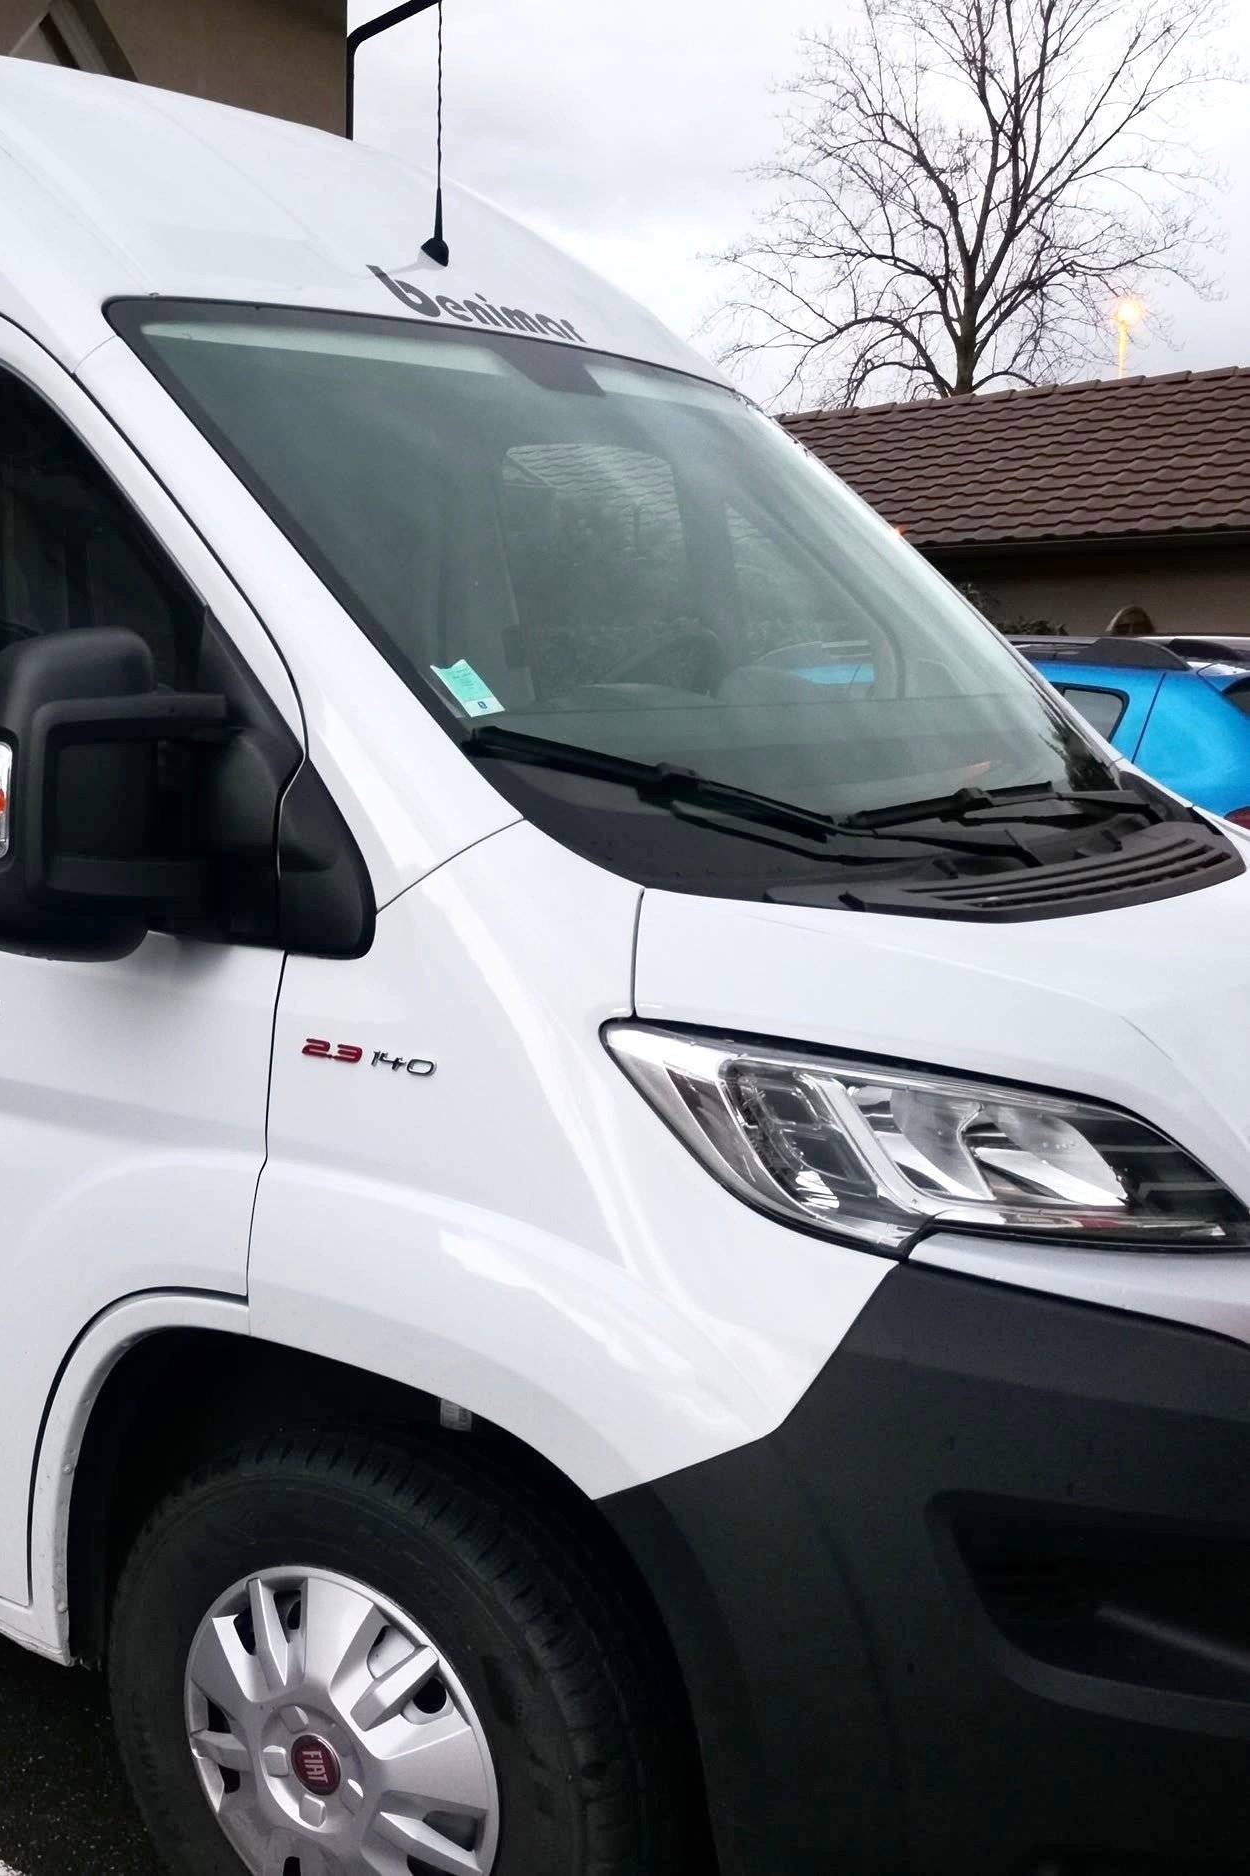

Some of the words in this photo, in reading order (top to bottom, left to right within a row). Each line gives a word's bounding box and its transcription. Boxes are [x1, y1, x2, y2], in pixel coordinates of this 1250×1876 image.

[365, 264, 588, 343] benimar
[301, 1038, 363, 1064] 2.3
[370, 1050, 437, 1077] 140
[302, 1750, 328, 1783] FIAT
